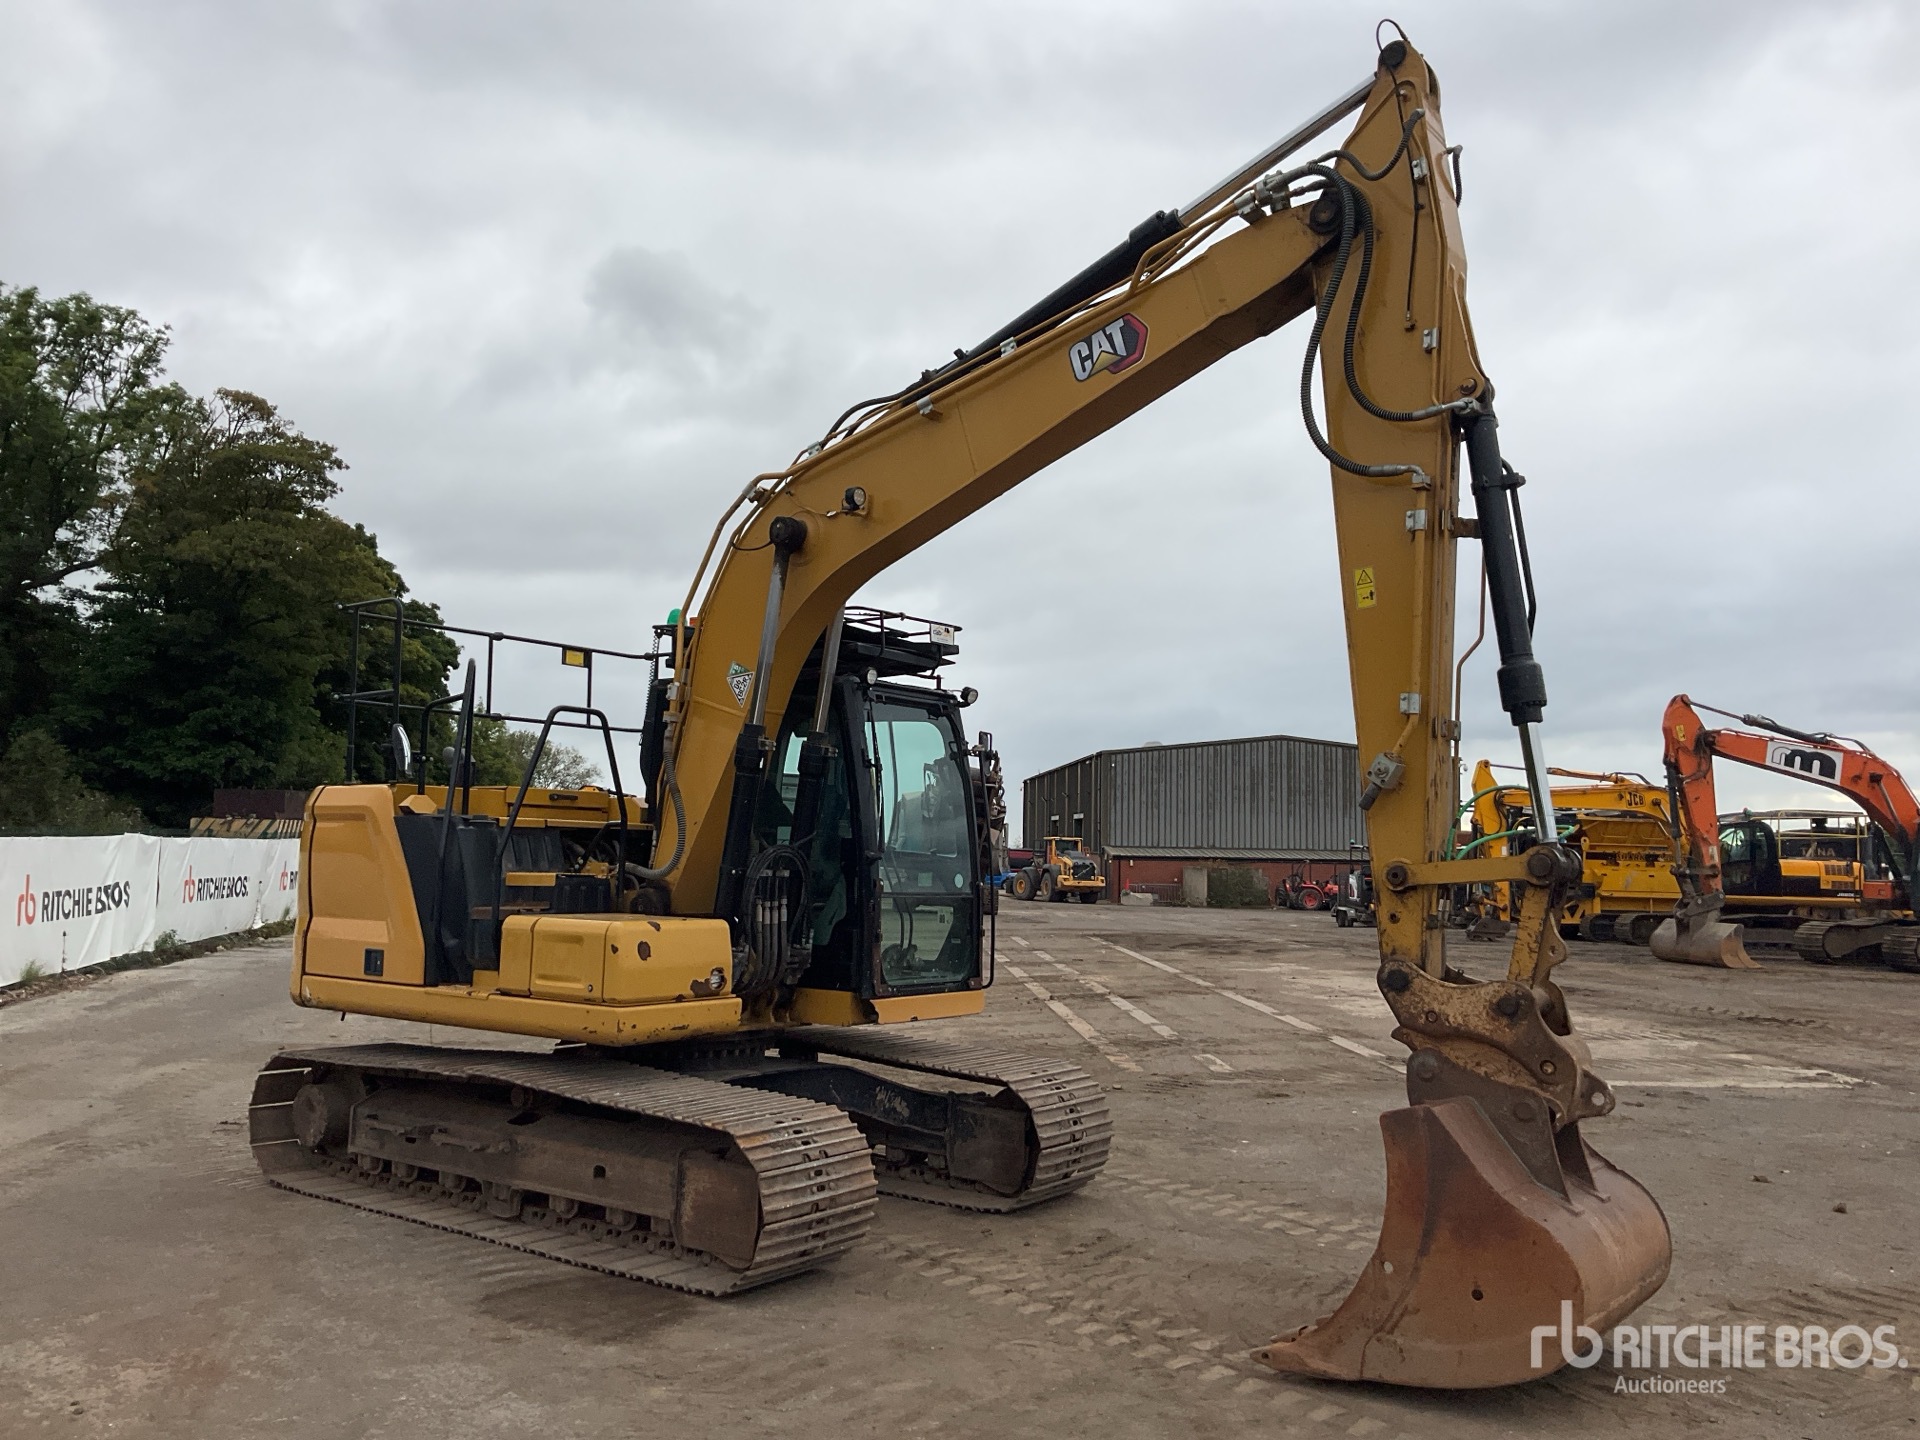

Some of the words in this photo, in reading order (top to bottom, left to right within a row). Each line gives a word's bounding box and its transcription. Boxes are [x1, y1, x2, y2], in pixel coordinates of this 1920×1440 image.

[1070, 318, 1127, 380] CAT
[1627, 791, 1644, 807] JCB
[17, 874, 36, 926] rb
[41, 887, 93, 922] RITCHIE
[182, 865, 196, 903] rb
[196, 877, 228, 902] RITCHIE
